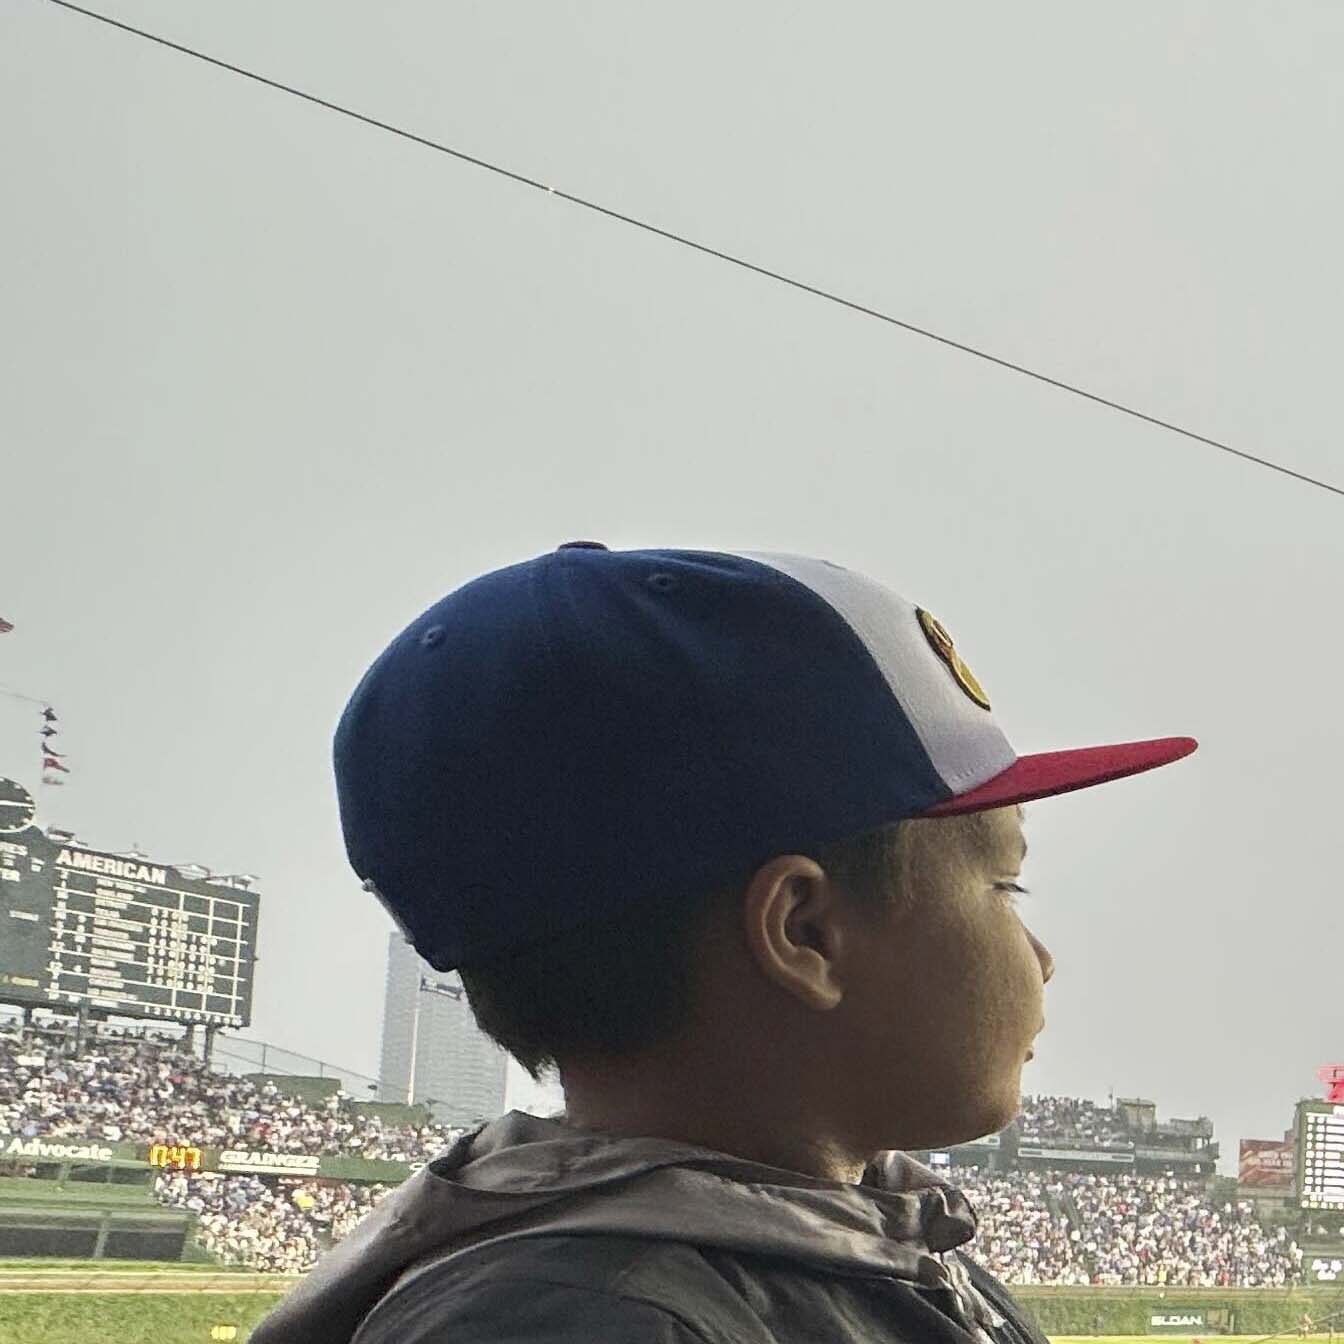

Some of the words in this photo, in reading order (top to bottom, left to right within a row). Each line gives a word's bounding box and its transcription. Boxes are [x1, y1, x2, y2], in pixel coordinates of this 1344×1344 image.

[56, 849, 166, 884] AMERICAN
[7, 1137, 112, 1161] Advocate
[220, 1150, 321, 1168] GRAINGER
[1151, 1315, 1202, 1326] SLOAN
